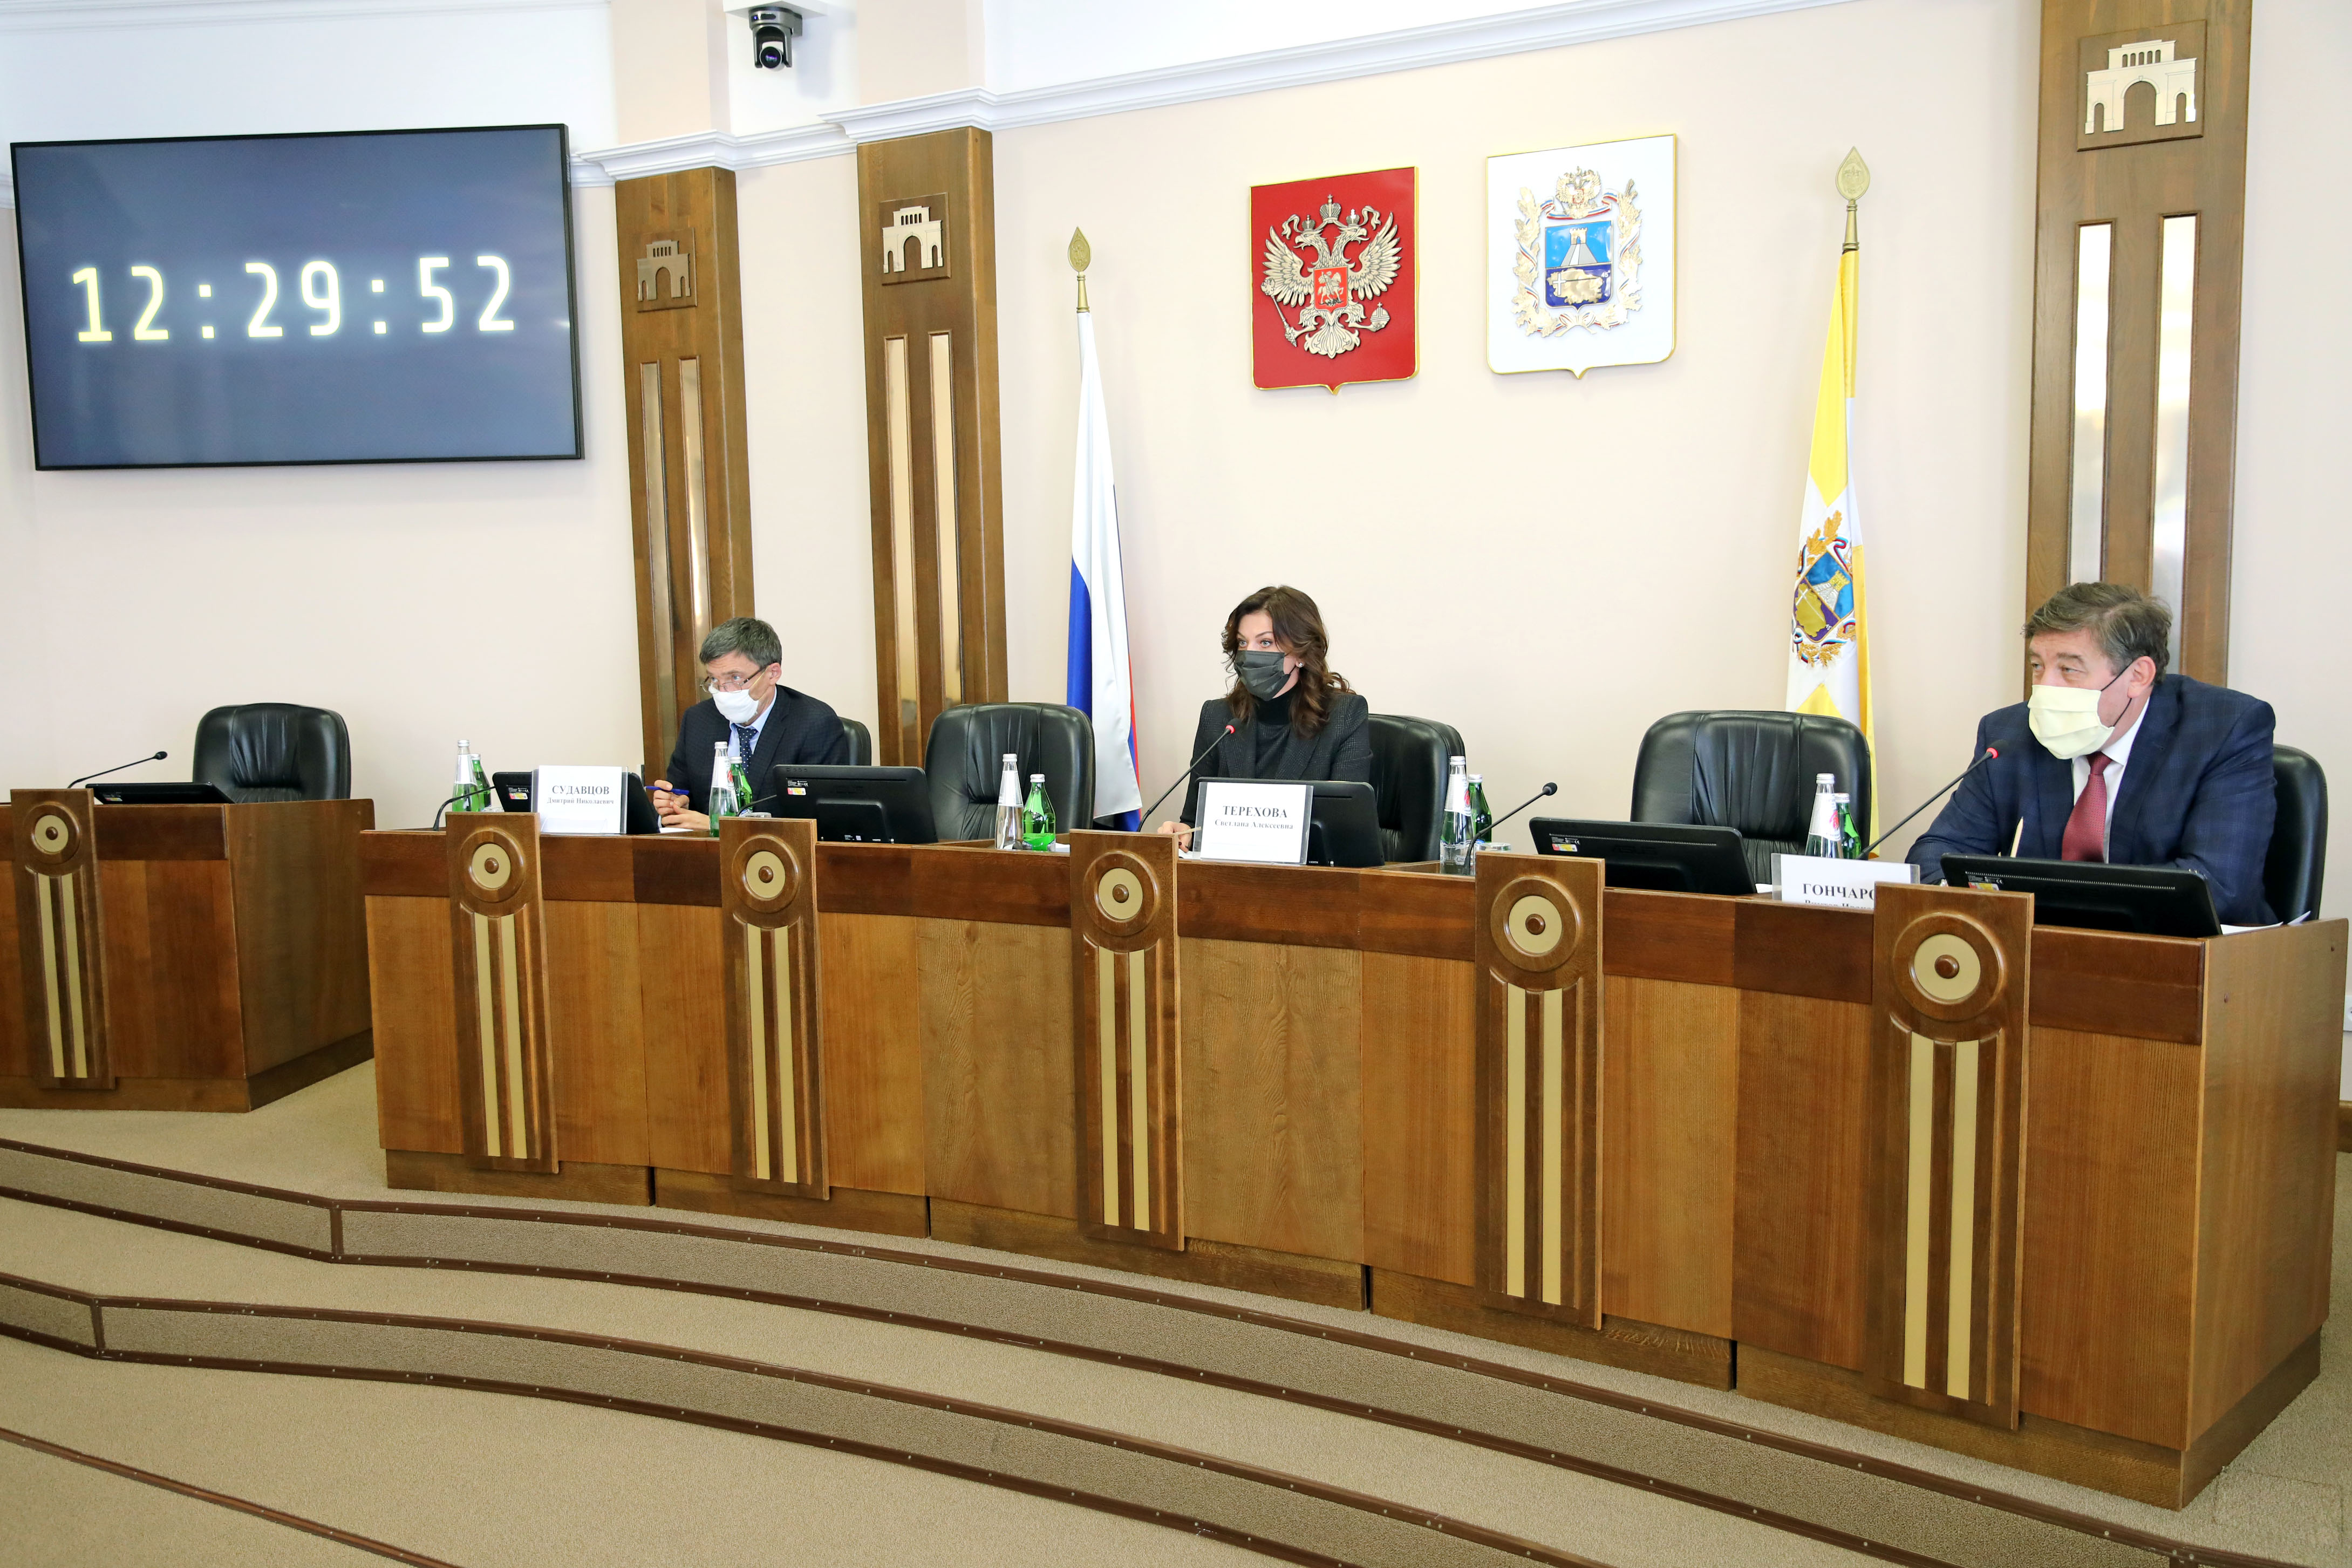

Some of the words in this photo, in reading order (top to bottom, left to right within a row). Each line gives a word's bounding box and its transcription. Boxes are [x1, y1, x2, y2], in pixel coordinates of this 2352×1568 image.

[552, 785, 610, 795] СУДАВЦОВ
[1223, 806, 1287, 818] ТЕРЕХОВА
[1215, 819, 1249, 827] Светлана
[1251, 821, 1293, 829] Алексеевна
